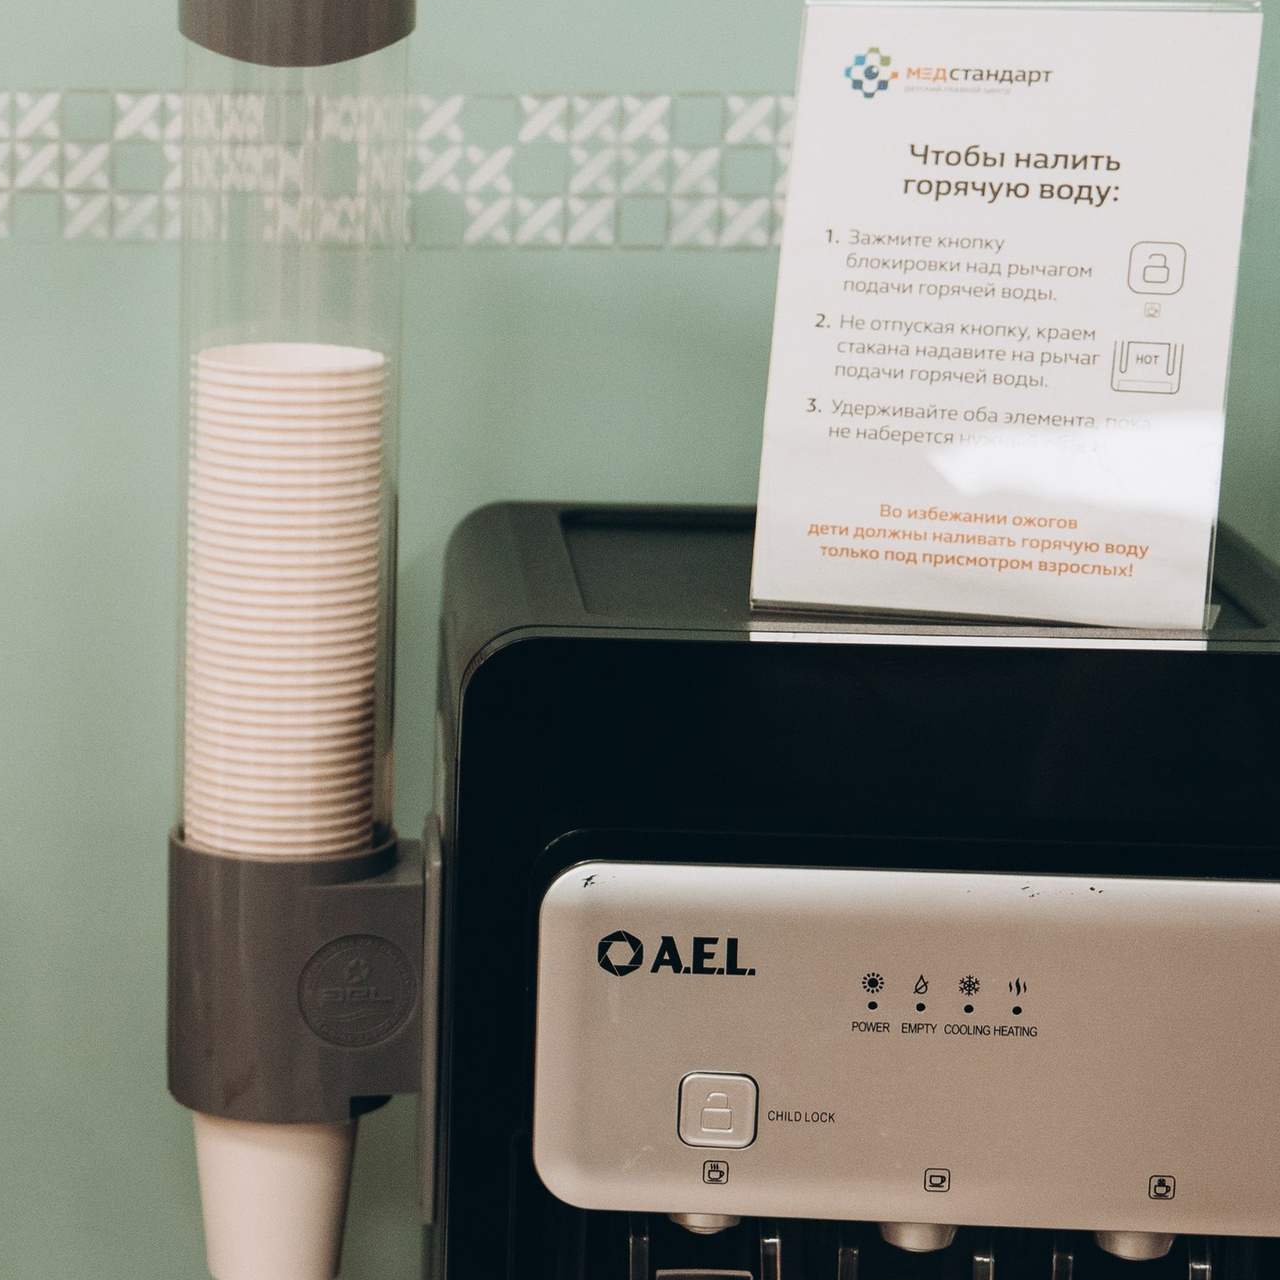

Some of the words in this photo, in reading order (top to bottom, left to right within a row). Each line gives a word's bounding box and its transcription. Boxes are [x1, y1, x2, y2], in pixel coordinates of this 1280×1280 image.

[909, 144, 1005, 168] Чтобы
[1015, 151, 1121, 171] налить
[903, 177, 1030, 201] горячую
[1039, 183, 1120, 206] воду:
[825, 229, 840, 244] 1.
[848, 229, 932, 248] Зажмите
[937, 235, 1005, 252] кнопку
[846, 253, 961, 276] блокировки
[966, 260, 1001, 275] над
[1007, 262, 1092, 282] рычагом
[843, 279, 913, 296] подачи
[919, 281, 996, 301] горячей
[1001, 285, 1057, 302] воды.
[815, 314, 830, 328] 2.
[839, 315, 865, 331] Не
[870, 319, 955, 338] отпуская
[960, 322, 1031, 341] кнопку,
[1036, 325, 1096, 342] краем
[837, 340, 910, 357] стакана
[915, 343, 1006, 362] надавите
[1011, 348, 1035, 363] на
[1040, 350, 1100, 368] рычаг
[1135, 353, 1160, 367] HOT
[835, 363, 904, 381] подачи
[910, 366, 987, 386] горячей
[992, 370, 1048, 388] воды.
[806, 398, 822, 413] 3.
[830, 399, 958, 423] Удерживайте
[963, 406, 999, 424] оба
[1004, 411, 1097, 431] элемента,
[828, 425, 851, 440] не
[856, 423, 954, 446] наберется
[880, 504, 902, 519] Во
[907, 505, 1008, 526] избежании
[1012, 515, 1078, 530] ожогов
[808, 522, 849, 538] дети
[853, 525, 927, 543] должны
[932, 531, 1016, 548] наливать
[1021, 535, 1100, 555] горячую
[1105, 541, 1149, 559] воду
[820, 545, 879, 561] только
[884, 548, 917, 566] под
[922, 550, 1033, 572] присмотром
[1038, 557, 1133, 578] взрослых!
[851, 1021, 890, 1034] POWER
[901, 1022, 937, 1035] EMPTY
[944, 1023, 991, 1037] COOLING
[993, 1025, 1038, 1038] HEATING
[767, 1110, 803, 1124] CHILD
[804, 1111, 836, 1124] LOCK
